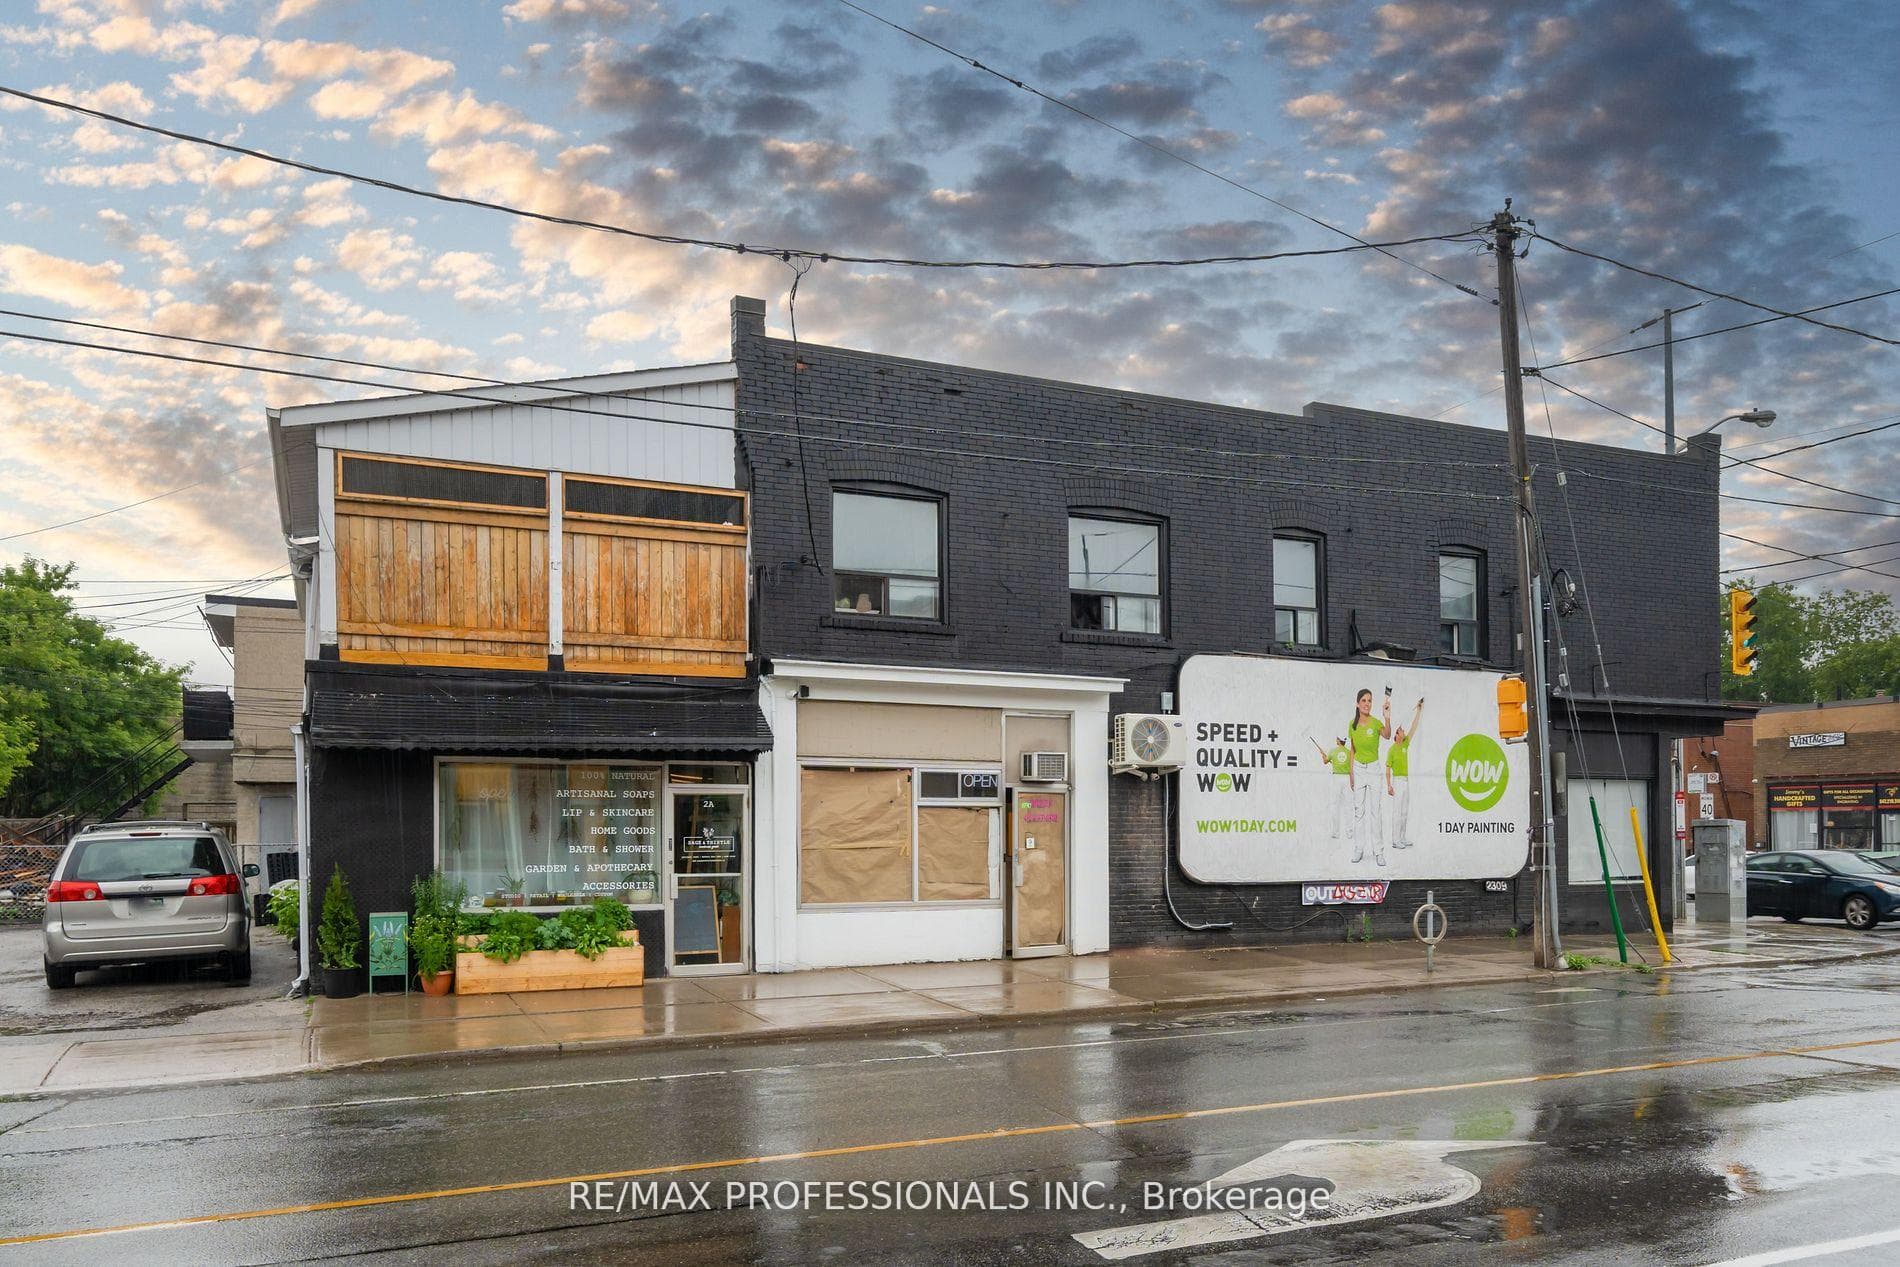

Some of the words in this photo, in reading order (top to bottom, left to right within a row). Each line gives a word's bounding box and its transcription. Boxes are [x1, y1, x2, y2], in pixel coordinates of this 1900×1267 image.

[1196, 722, 1262, 743] SPEED
[1267, 730, 1278, 742] +
[1791, 735, 1827, 747] VINTAGE
[1196, 747, 1282, 768] QUALITY
[1287, 755, 1297, 767] =
[611, 772, 656, 780] NATURAL
[1450, 759, 1504, 784] WOW
[963, 774, 998, 788] OPEN
[1196, 773, 1251, 793] WOW
[556, 789, 617, 798] ARTISANAL
[622, 790, 655, 799] SOAPS
[703, 800, 715, 808] 2A
[1701, 803, 1713, 815] 40
[562, 808, 583, 817] LIP
[589, 809, 596, 817] &
[602, 808, 655, 817] SKINCARE
[591, 826, 618, 835] HOME
[623, 826, 656, 835] GOODS
[1196, 819, 1297, 833] WOW1DAY.COM
[1438, 822, 1443, 833] 1
[1445, 822, 1466, 833] DAY
[1467, 822, 1515, 834] PAINTING
[569, 845, 596, 854] BATH
[602, 845, 609, 853] &
[615, 845, 655, 854] SHOWER
[525, 864, 568, 873] GARDEN
[573, 864, 580, 873] &
[586, 863, 654, 872] APOTHECARY
[582, 881, 656, 891] ACCESSORIES
[1486, 880, 1507, 891] 2309
